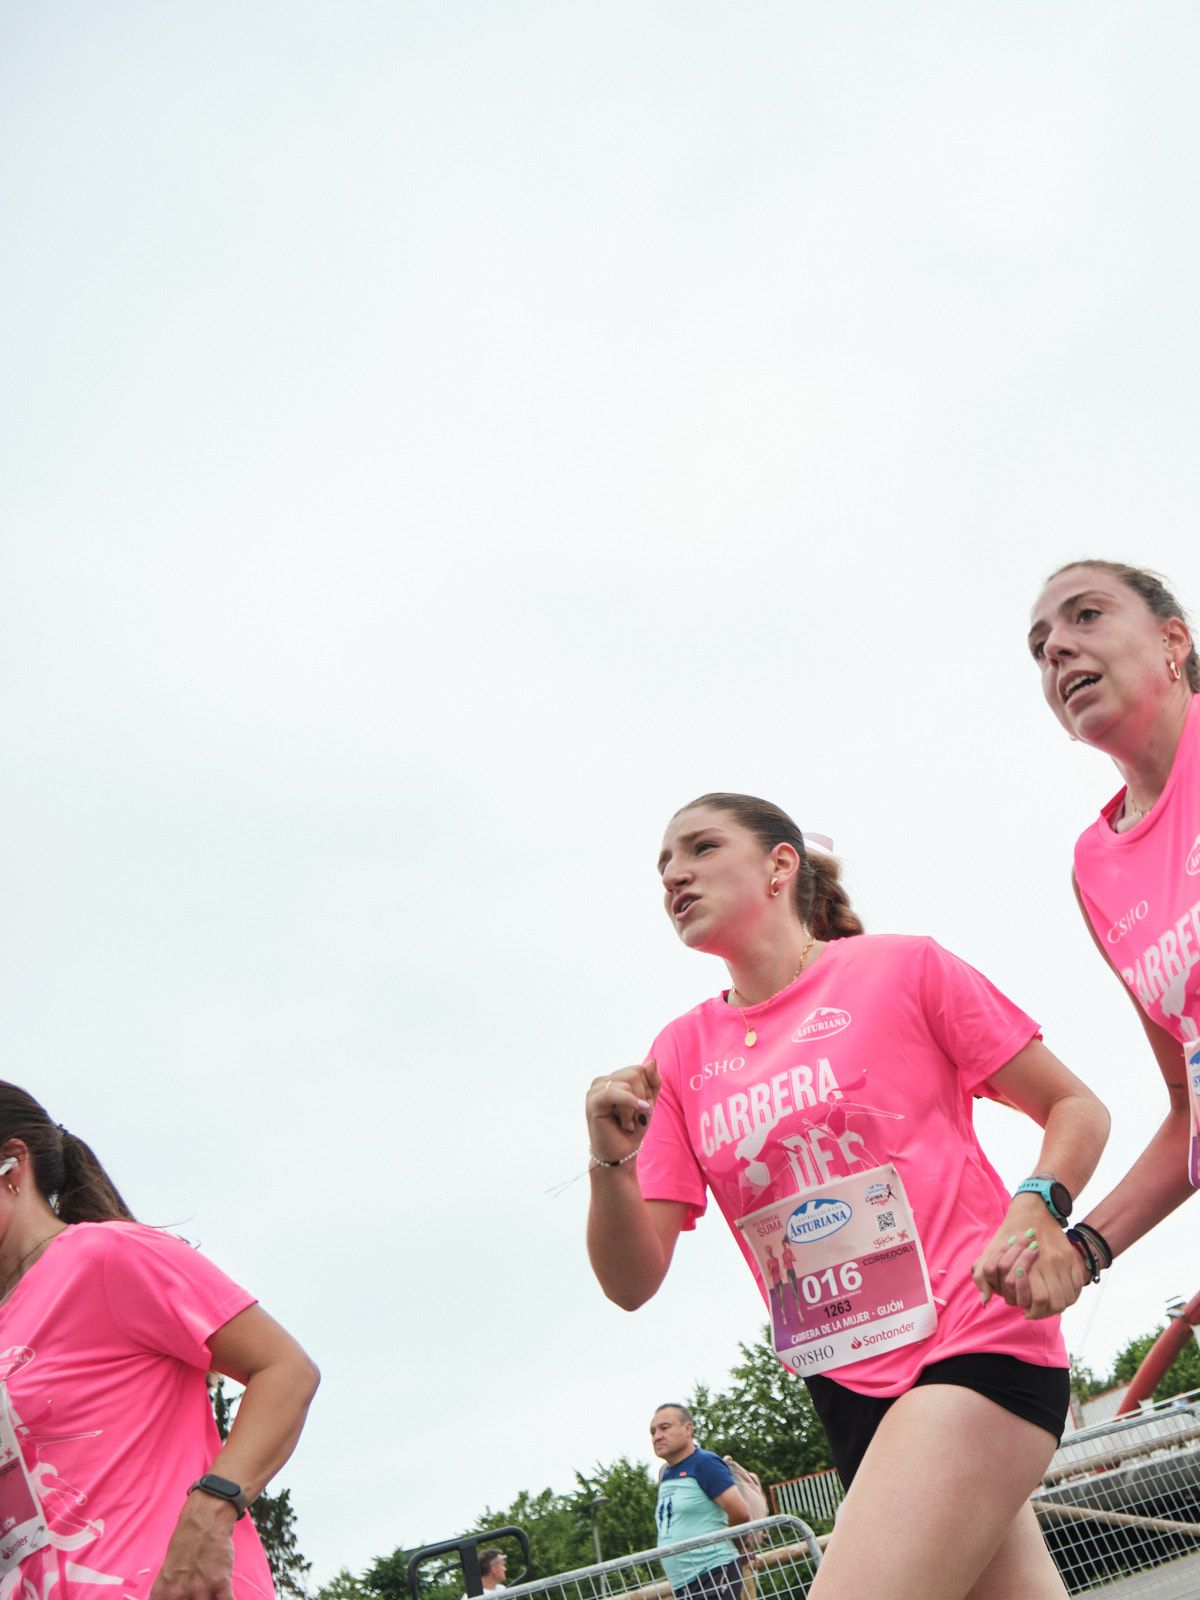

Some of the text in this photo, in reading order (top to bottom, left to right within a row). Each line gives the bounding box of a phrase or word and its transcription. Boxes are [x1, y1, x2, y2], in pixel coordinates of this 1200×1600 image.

[797, 1016, 848, 1038] ASTURIANA
[700, 1057, 844, 1157] CARRERA
[757, 1219, 784, 1237] SUMA
[790, 1210, 847, 1238] ASTURIANA
[801, 1261, 863, 1304] 016
[791, 1327, 822, 1345] CARRERA
[821, 1322, 832, 1335] DE
[832, 1318, 843, 1331] LA
[843, 1311, 871, 1328] MUJER
[877, 1299, 905, 1317] GIJÓN
[824, 1299, 852, 1319] 1263
[863, 1321, 916, 1347] Santander
[791, 1344, 834, 1369] OYSHO
